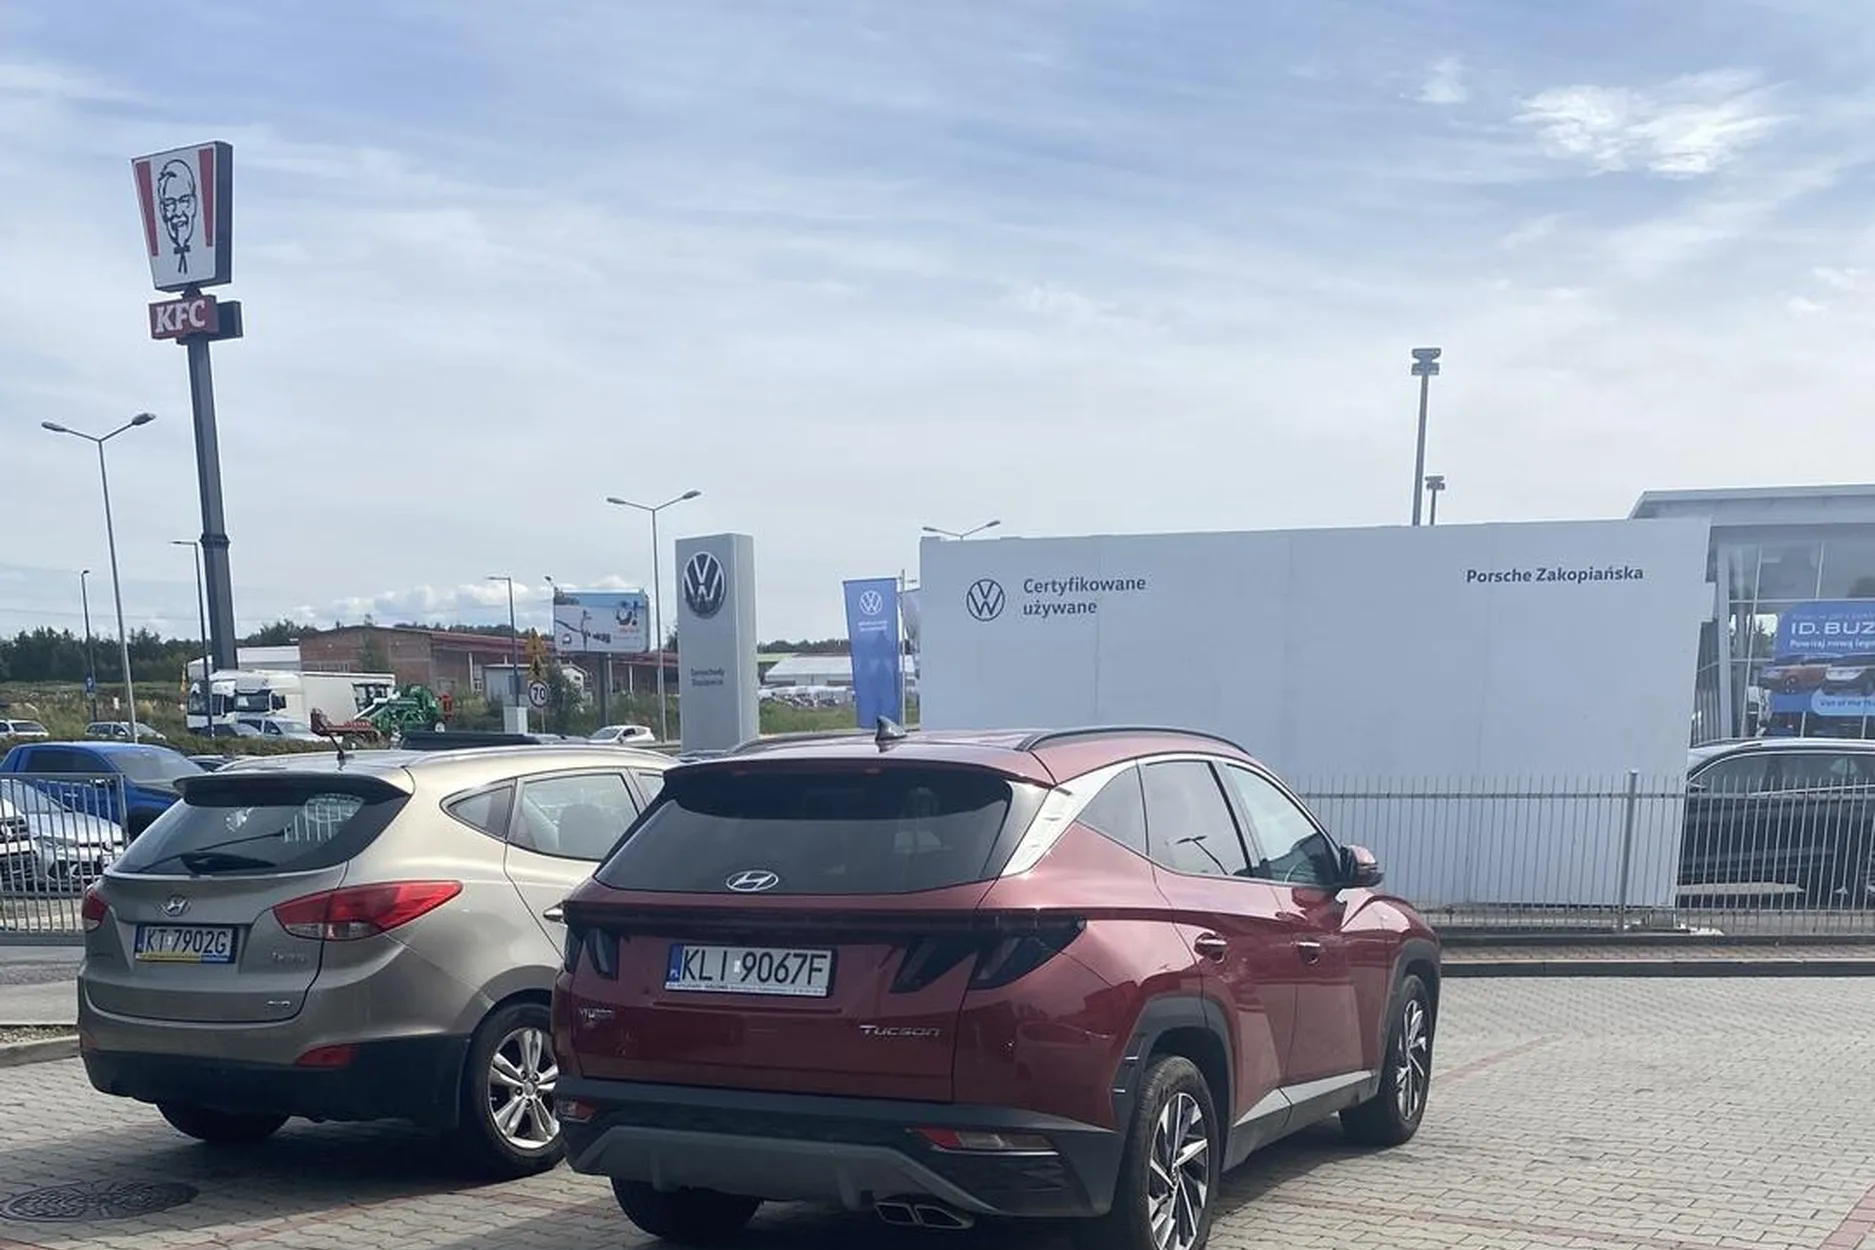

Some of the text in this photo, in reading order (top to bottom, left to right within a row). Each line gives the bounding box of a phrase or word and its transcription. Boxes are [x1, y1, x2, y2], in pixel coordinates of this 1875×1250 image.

[155, 299, 206, 334] KFC
[1466, 566, 1644, 584] Porsche Zakopiańska
[1023, 577, 1147, 596] Certyfikowane
[1023, 600, 1098, 618] używane
[533, 687, 546, 700] 70
[145, 929, 228, 954] KT 7902G
[682, 949, 828, 986] KLI 9067F
